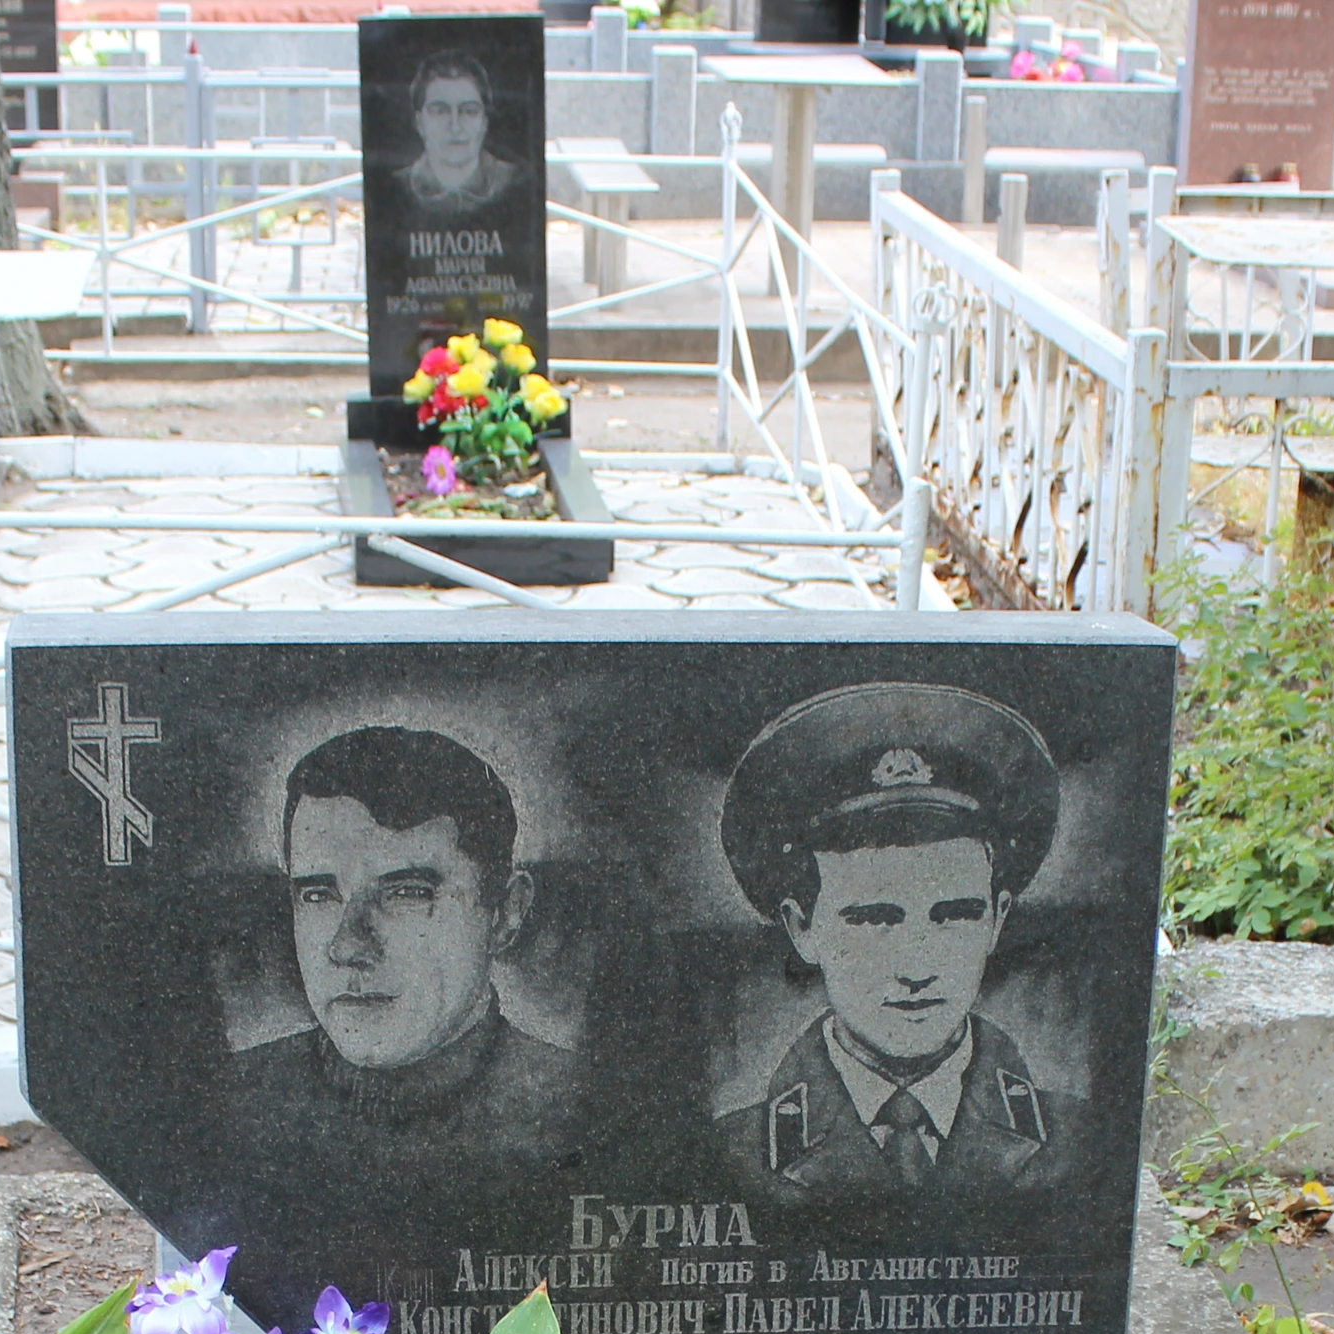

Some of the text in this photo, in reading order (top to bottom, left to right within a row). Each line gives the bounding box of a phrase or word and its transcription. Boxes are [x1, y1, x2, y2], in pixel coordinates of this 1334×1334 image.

[409, 230, 504, 258] НИЛОВА
[569, 1194, 758, 1250] БУРМА
[661, 1257, 755, 1286] ПОГИБ
[809, 1250, 1020, 1282] АВГАНИСТАНЕ
[723, 1289, 1084, 1334] ПАВЕЛ АЛЕКСЕЕВИЧ
